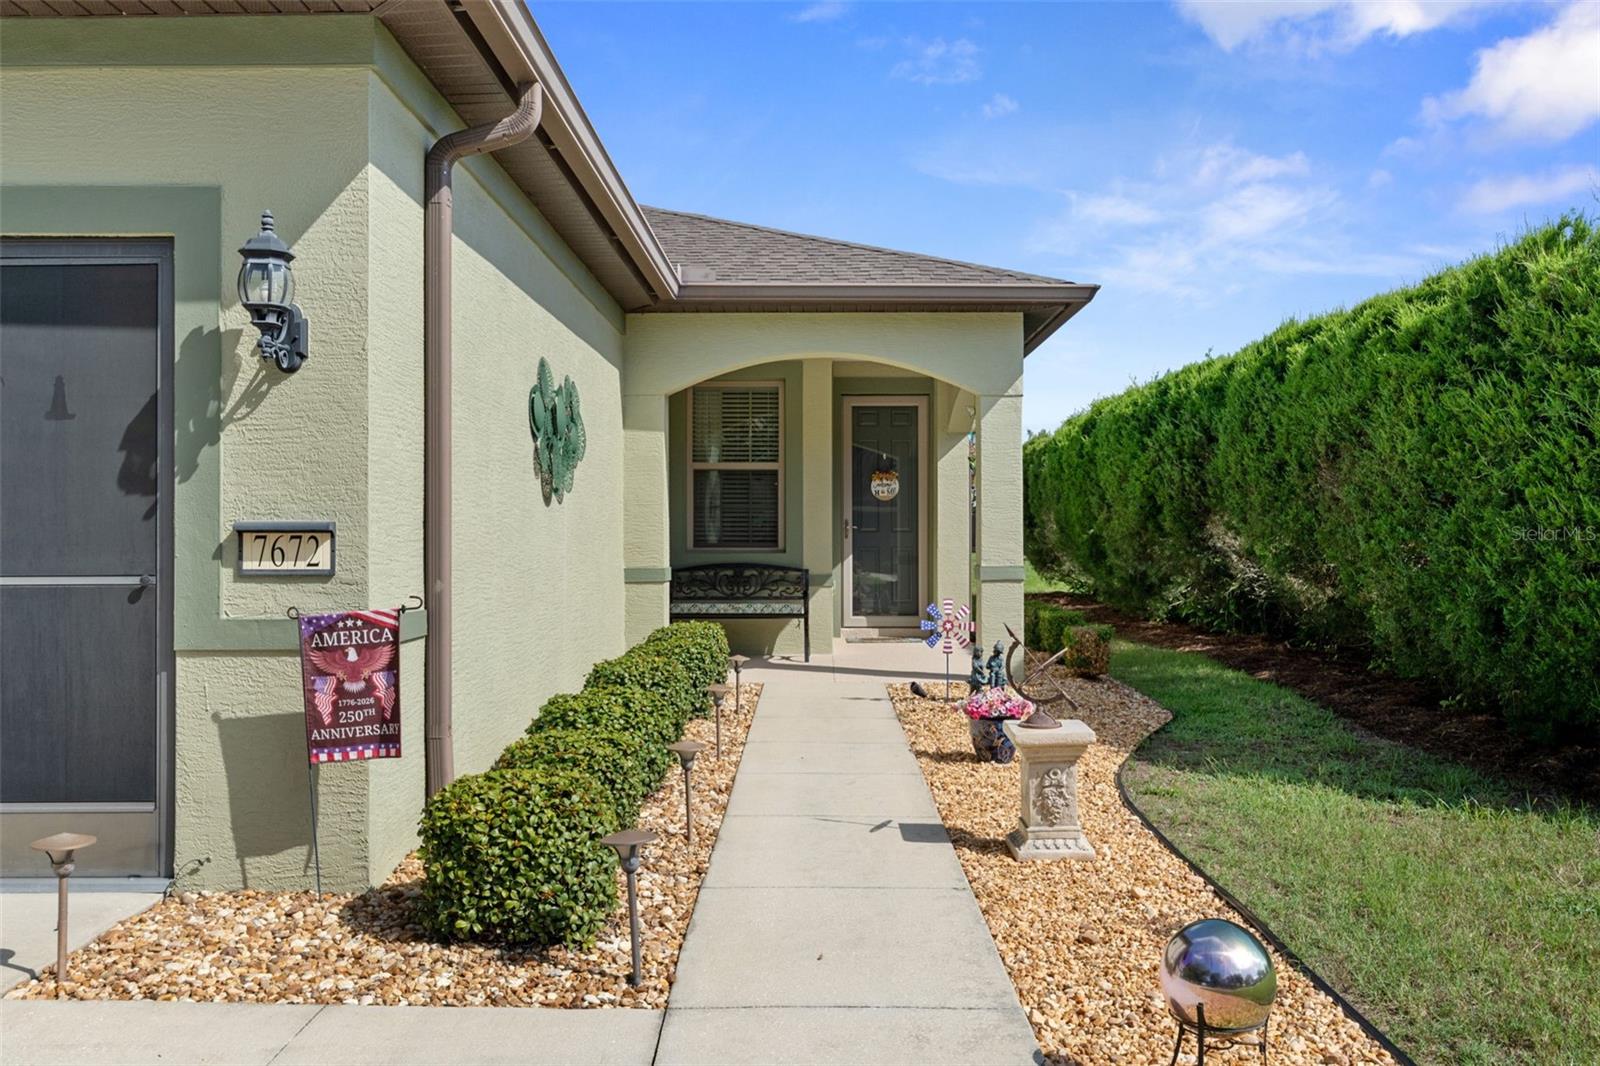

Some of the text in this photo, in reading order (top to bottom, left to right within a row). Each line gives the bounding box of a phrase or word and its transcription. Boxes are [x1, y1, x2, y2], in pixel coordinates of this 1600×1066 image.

[253, 534, 321, 567] 7672
[311, 628, 394, 648] AMERICA
[338, 697, 375, 707] 1776-2026
[339, 708, 376, 723] 250TH
[311, 723, 400, 740] ANNIVERSARY
